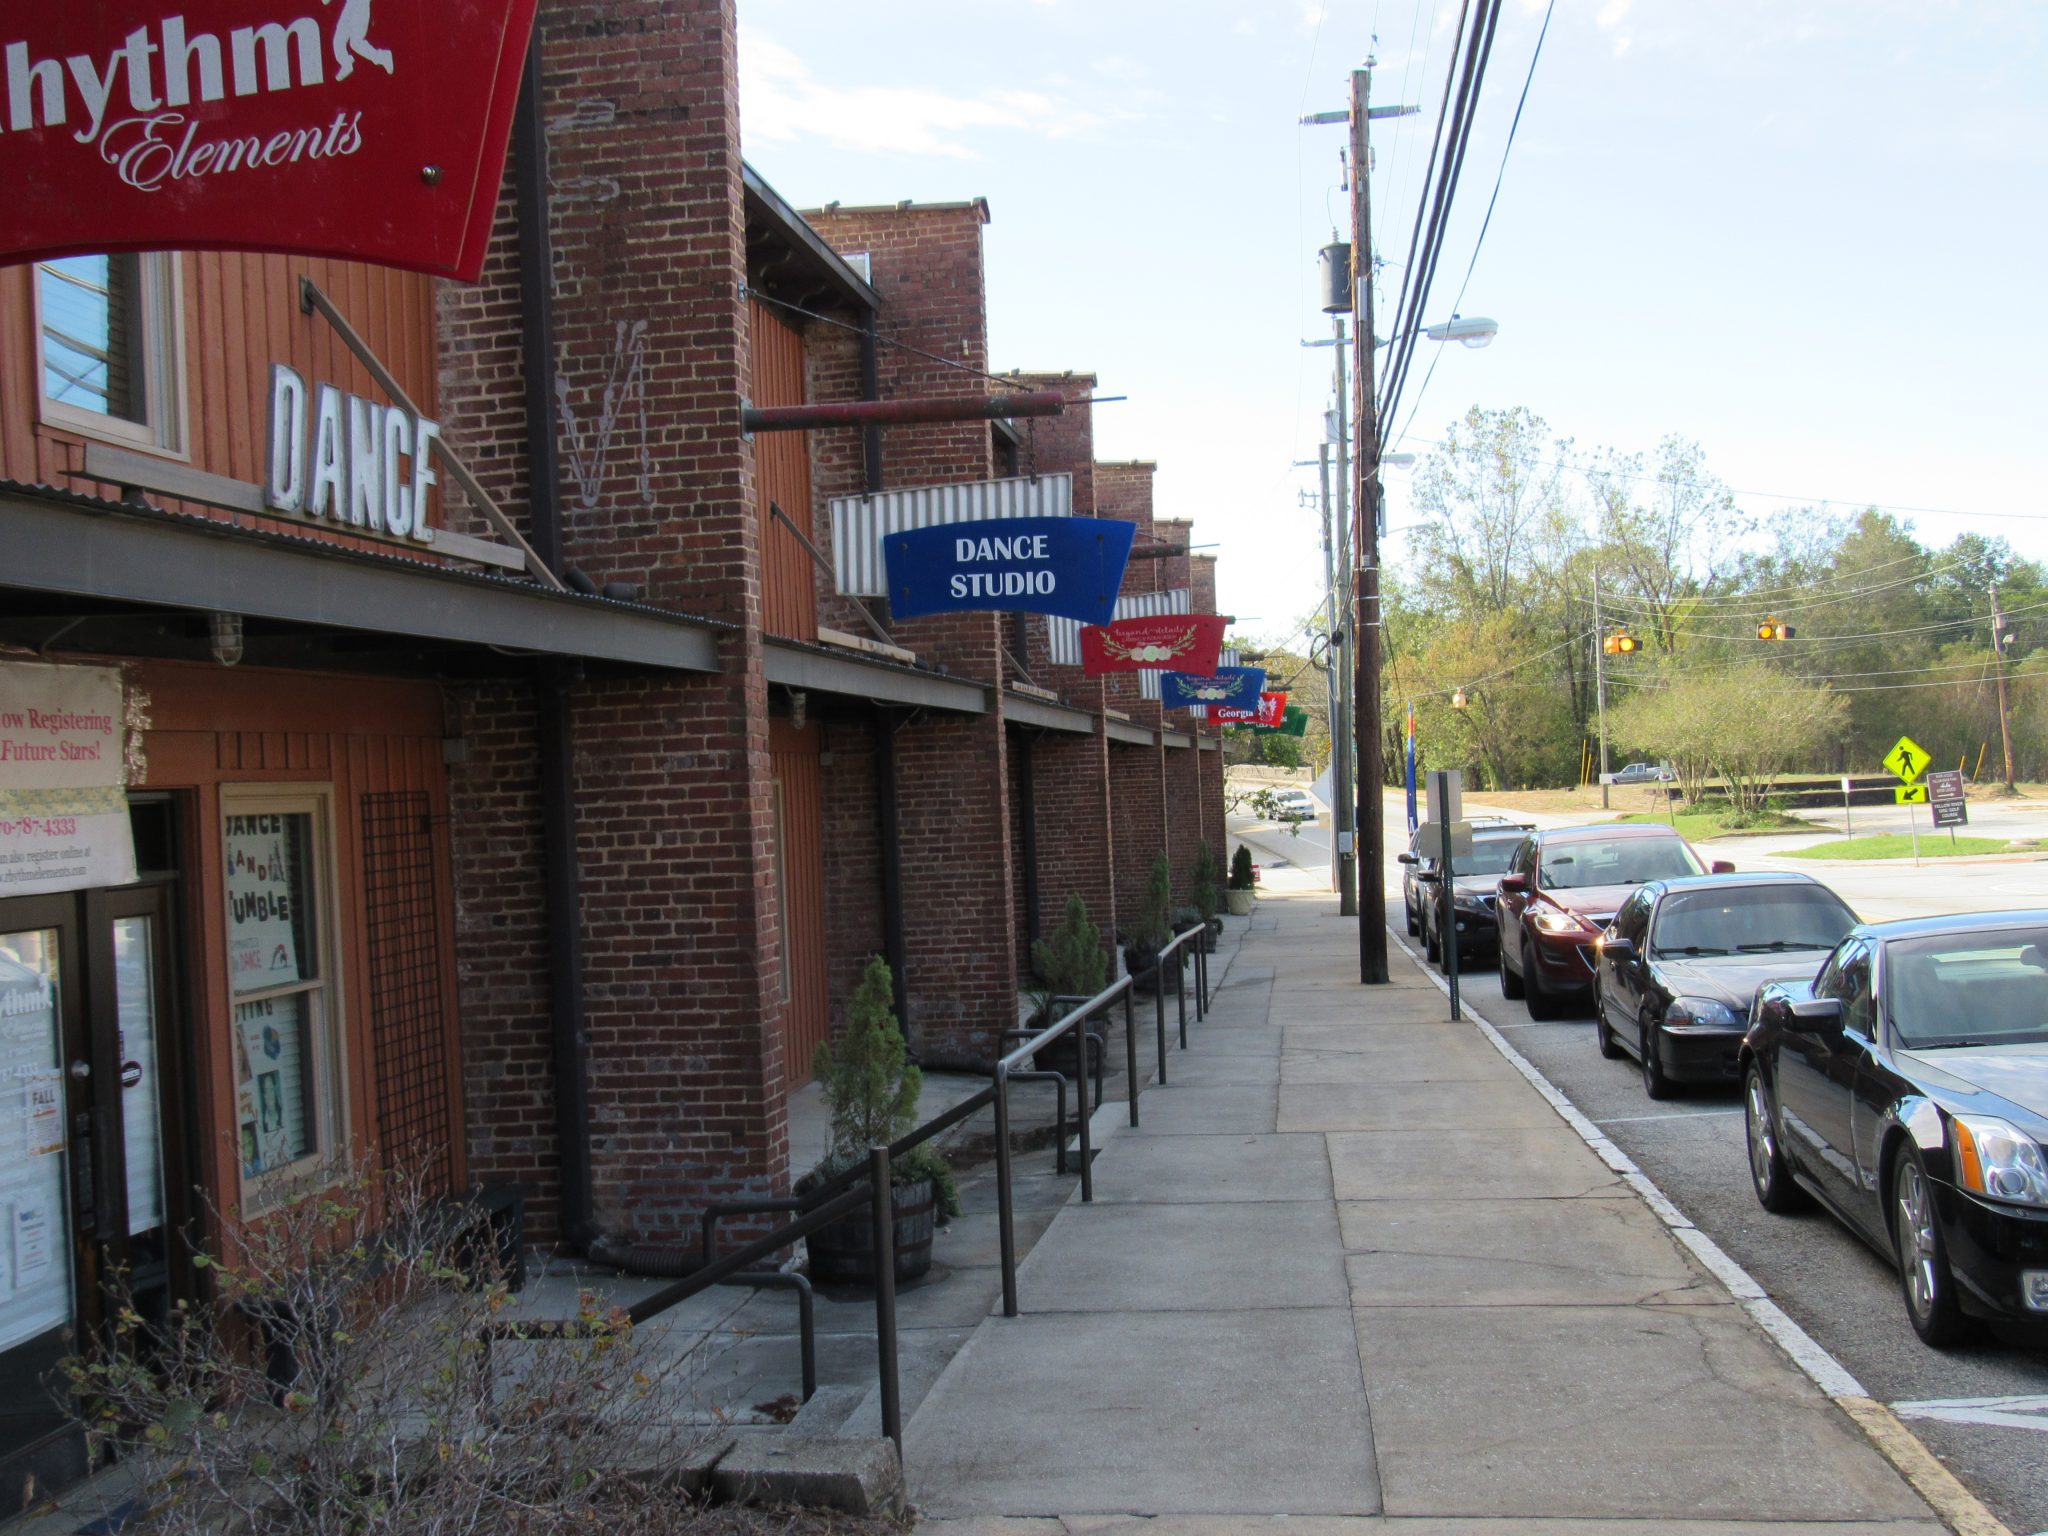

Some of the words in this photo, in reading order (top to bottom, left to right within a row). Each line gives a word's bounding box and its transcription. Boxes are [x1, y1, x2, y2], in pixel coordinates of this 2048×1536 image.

[0, 15, 324, 144] hythm
[101, 111, 362, 192] Elements
[265, 363, 441, 543] DANCE
[956, 535, 1050, 562] DANCE
[950, 570, 1056, 598] STUDIO
[0, 712, 24, 729] ow
[27, 708, 112, 735] Registering
[1217, 708, 1254, 719] Georgia
[0, 740, 57, 761] Future
[60, 740, 100, 760] Stars!
[0, 816, 77, 837] 0-787-4333
[236, 850, 267, 882] AND
[32, 1088, 56, 1106] FALL
